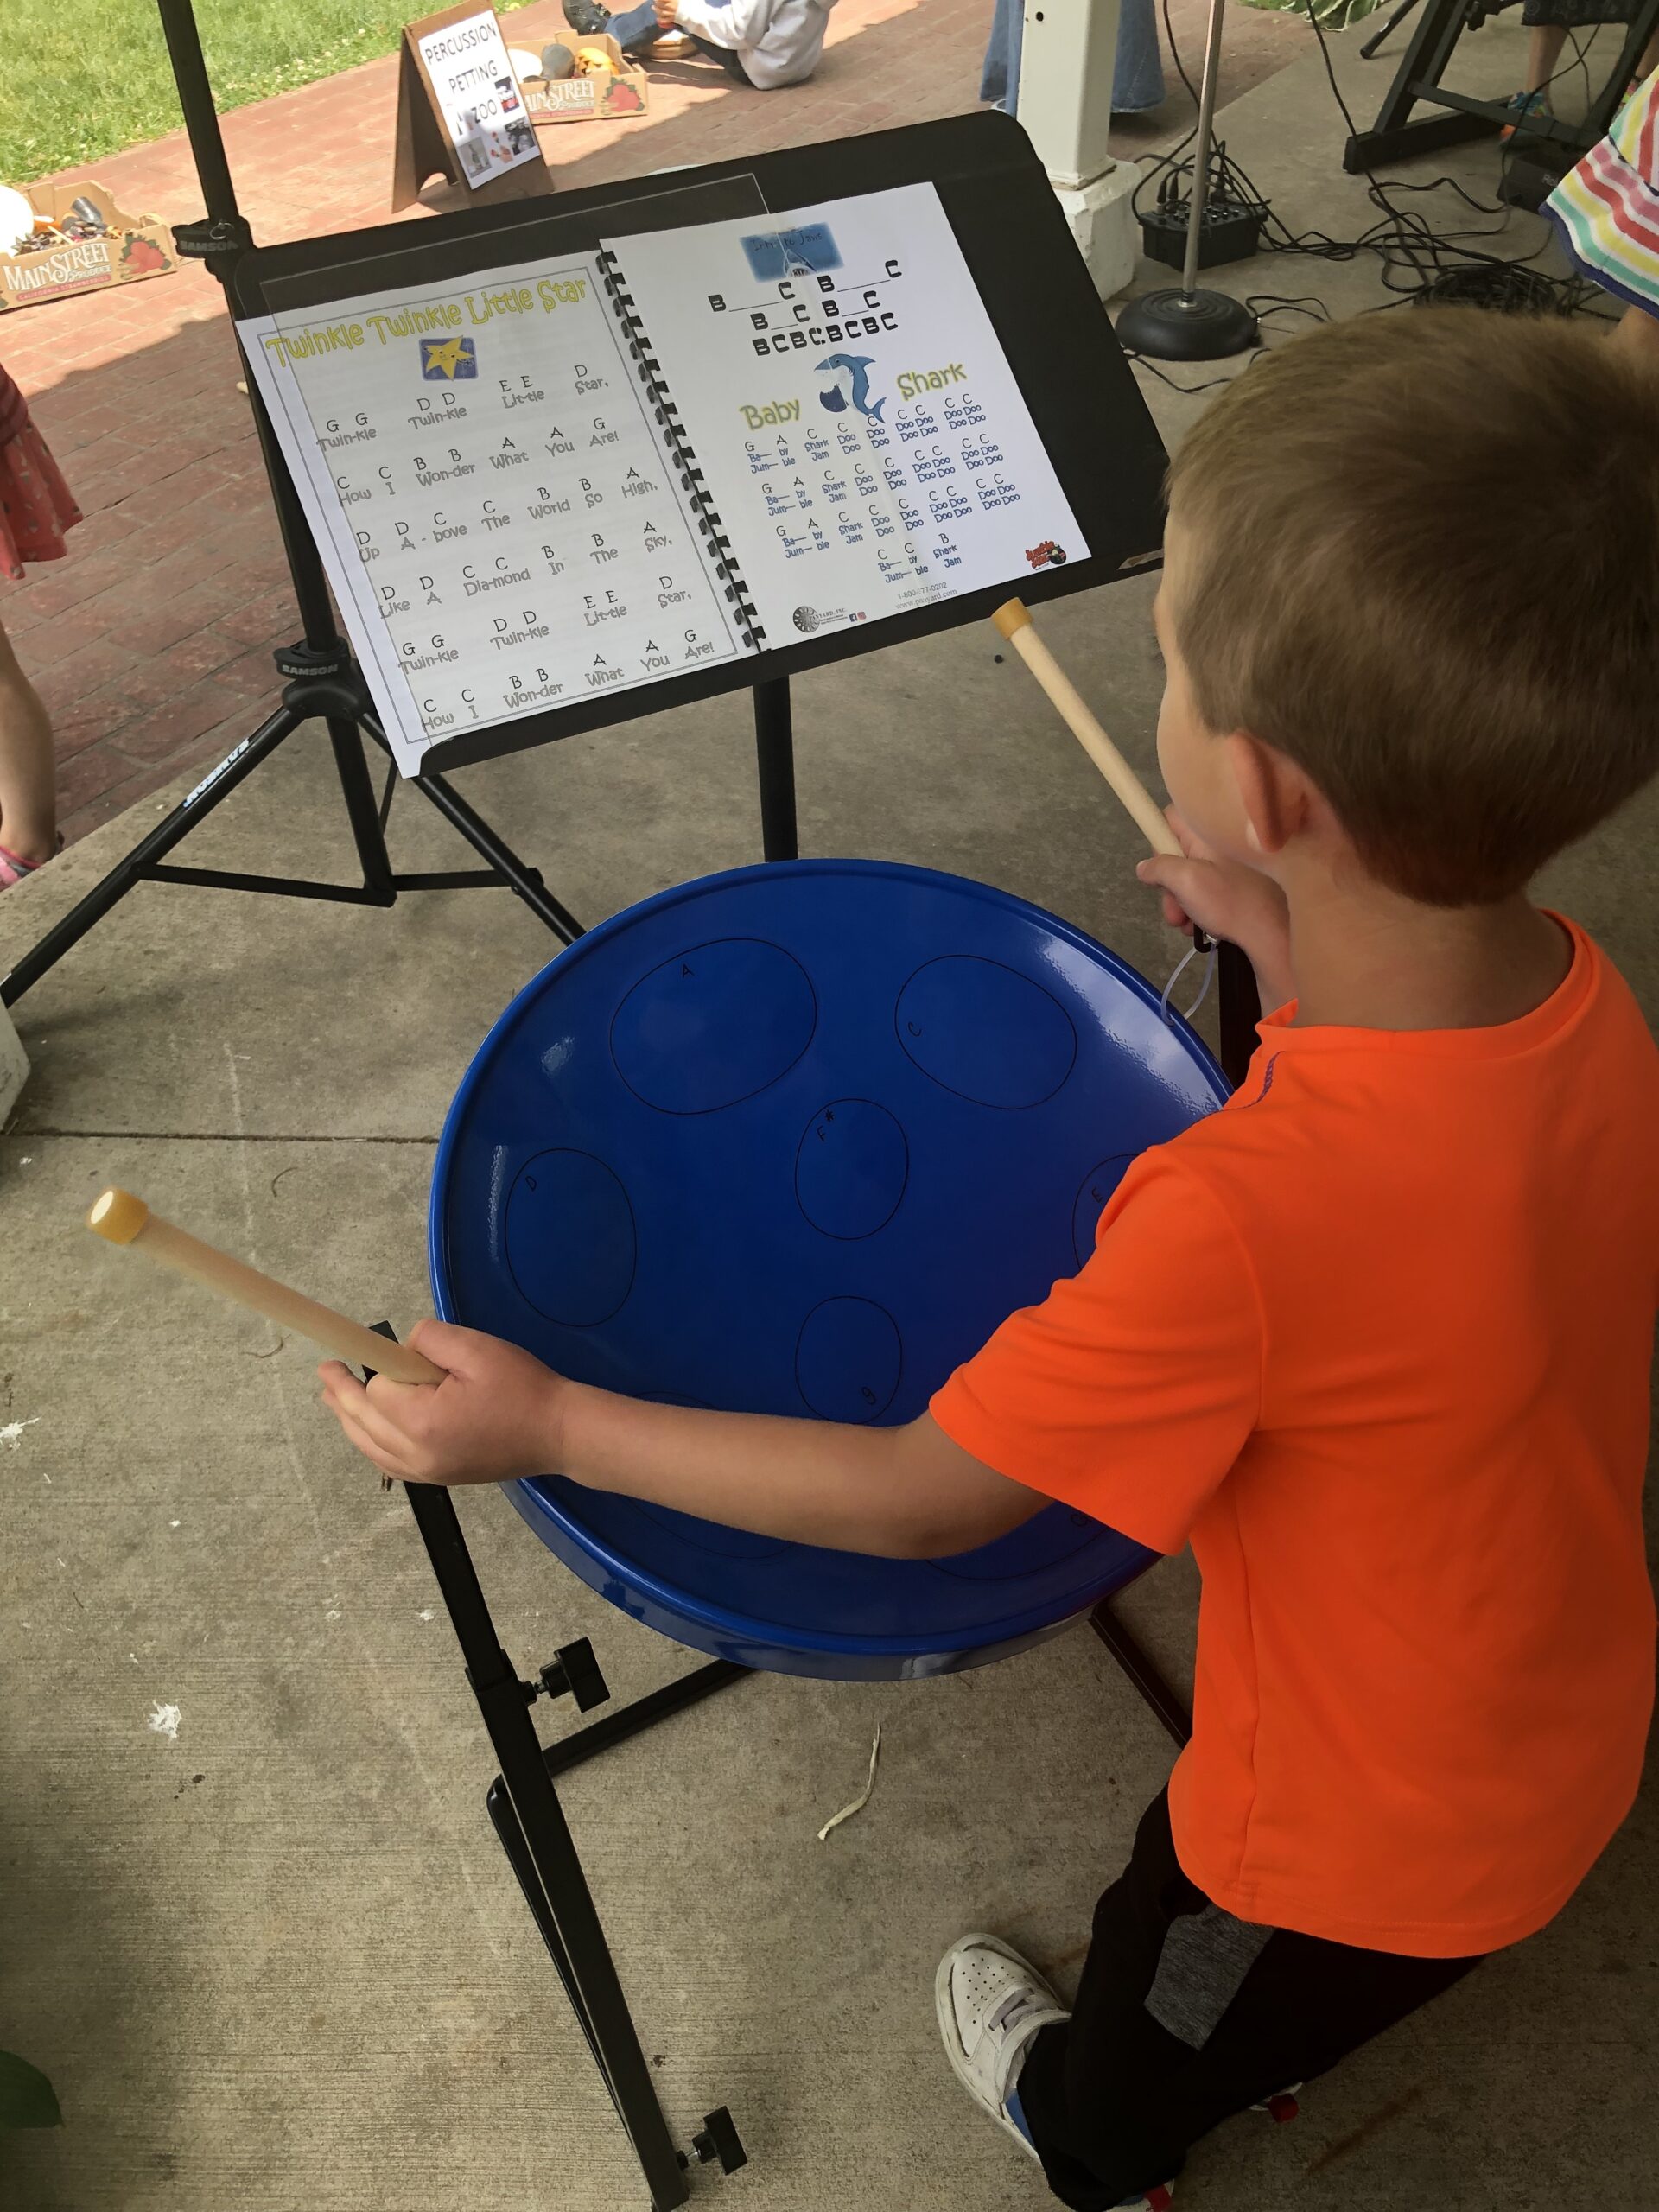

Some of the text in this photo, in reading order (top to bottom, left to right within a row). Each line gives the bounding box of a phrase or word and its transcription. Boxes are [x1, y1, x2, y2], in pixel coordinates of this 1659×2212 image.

[425, 22, 497, 65] PERCUSSION
[448, 60, 499, 94] PETTING
[472, 99, 498, 124] ZOO
[2, 243, 110, 290] MAIN STREET
[265, 277, 586, 368] Twinkle Twinkle Little Star
[316, 429, 377, 452] Twin-kle
[408, 407, 467, 429] Twin-kle
[575, 378, 608, 395] Star,
[327, 365, 588, 432] G G D D E E D
[740, 364, 967, 430] Baby Shark
[745, 394, 972, 452] G A C C C C C C C
[337, 418, 605, 489] C C B B A A G
[779, 448, 788, 456] by
[804, 440, 830, 452] Shark
[837, 434, 855, 444] Doo
[866, 429, 885, 439] Doo
[895, 422, 914, 432] Doo
[915, 416, 933, 427] Doo
[944, 410, 963, 420] Doo
[963, 405, 982, 416] Doo
[782, 458, 795, 467] ble
[811, 451, 830, 461] Jam
[842, 444, 861, 454] Doo
[871, 438, 890, 449] Doo
[900, 431, 918, 442] Doo
[919, 426, 938, 437] Doo
[949, 419, 967, 430] Doo
[968, 415, 986, 425] Doo
[339, 431, 619, 506] How I Won-der What You Are!
[356, 467, 639, 545] D D C C B B A
[359, 480, 658, 563] Up A bove The World So High,
[381, 521, 657, 600] D D C C B B A
[878, 533, 949, 560] C C B
[908, 556, 917, 564] by
[933, 545, 957, 559] Shark
[914, 565, 928, 575] ble
[944, 557, 962, 568] Jam
[378, 536, 672, 619] Like A Dia-mond In The Sky,
[398, 648, 459, 674] Twin-kle
[490, 625, 550, 650] Twin-kle
[658, 591, 691, 608] Star,
[403, 576, 672, 656] G G D D E E D
[282, 664, 339, 676] SAMSON
[422, 642, 714, 732] How I Won-der What You Are!
[423, 629, 696, 712] C C B B A A G
[682, 963, 695, 979] A
[908, 1021, 922, 1037] C
[524, 1175, 537, 1192] D
[1091, 1187, 1104, 1204] E
